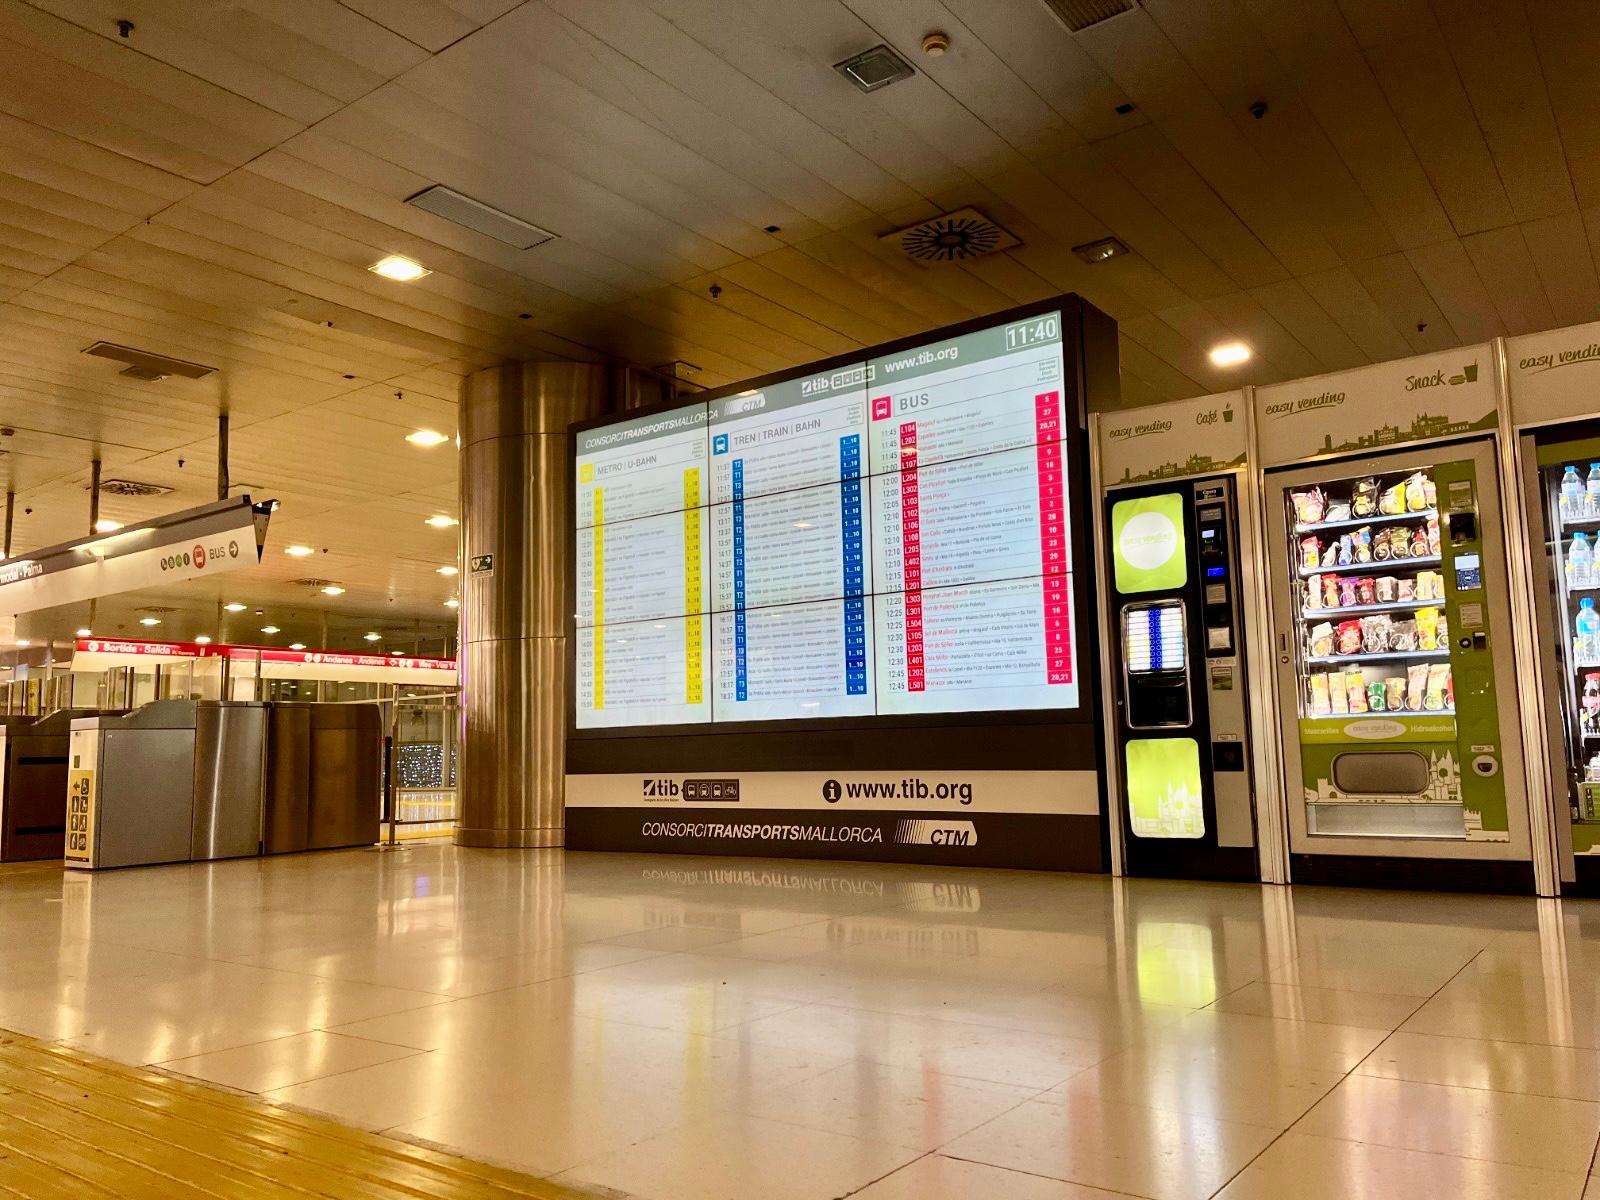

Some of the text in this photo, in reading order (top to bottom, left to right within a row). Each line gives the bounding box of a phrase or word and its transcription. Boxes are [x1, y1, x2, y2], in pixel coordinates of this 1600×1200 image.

[1008, 319, 1056, 347] 11:40
[885, 346, 958, 373] www.tib.org
[1520, 354, 1553, 370] easy
[813, 378, 829, 391] tib
[1405, 370, 1446, 392] Snack
[900, 393, 929, 411] BUS
[1265, 392, 1345, 415] easy vending
[1196, 409, 1218, 425] Café
[901, 424, 915, 433] L104
[902, 436, 915, 446] L202
[1043, 408, 1052, 416] 27
[1040, 421, 1056, 430] 20,21
[1109, 420, 1173, 439] easy vending
[734, 419, 821, 446] TREN TRAIN BAHN
[597, 455, 657, 475] METRO U-BAHN
[902, 460, 916, 469] L107
[903, 473, 916, 482] L204
[903, 485, 917, 494] L302
[903, 497, 917, 506] L103
[904, 509, 917, 518] L102
[904, 521, 918, 530] L106
[904, 533, 918, 542] L108
[209, 547, 226, 558] BUS
[905, 545, 919, 554] L205
[23, 563, 43, 578] Palma
[905, 570, 919, 578] L101
[906, 582, 920, 590] L201
[906, 595, 920, 603] L303
[907, 607, 920, 615] L301
[908, 632, 922, 640] L105
[144, 645, 170, 655] Salida
[908, 644, 922, 652] L203
[908, 656, 922, 664] L401
[909, 669, 923, 677] L202
[910, 681, 923, 689] L501
[657, 779, 679, 796] tib
[846, 778, 972, 804] www.tib.org
[642, 822, 883, 844] CONSORCITRANSPORTSMALLORCA
[930, 828, 971, 846] CTM
